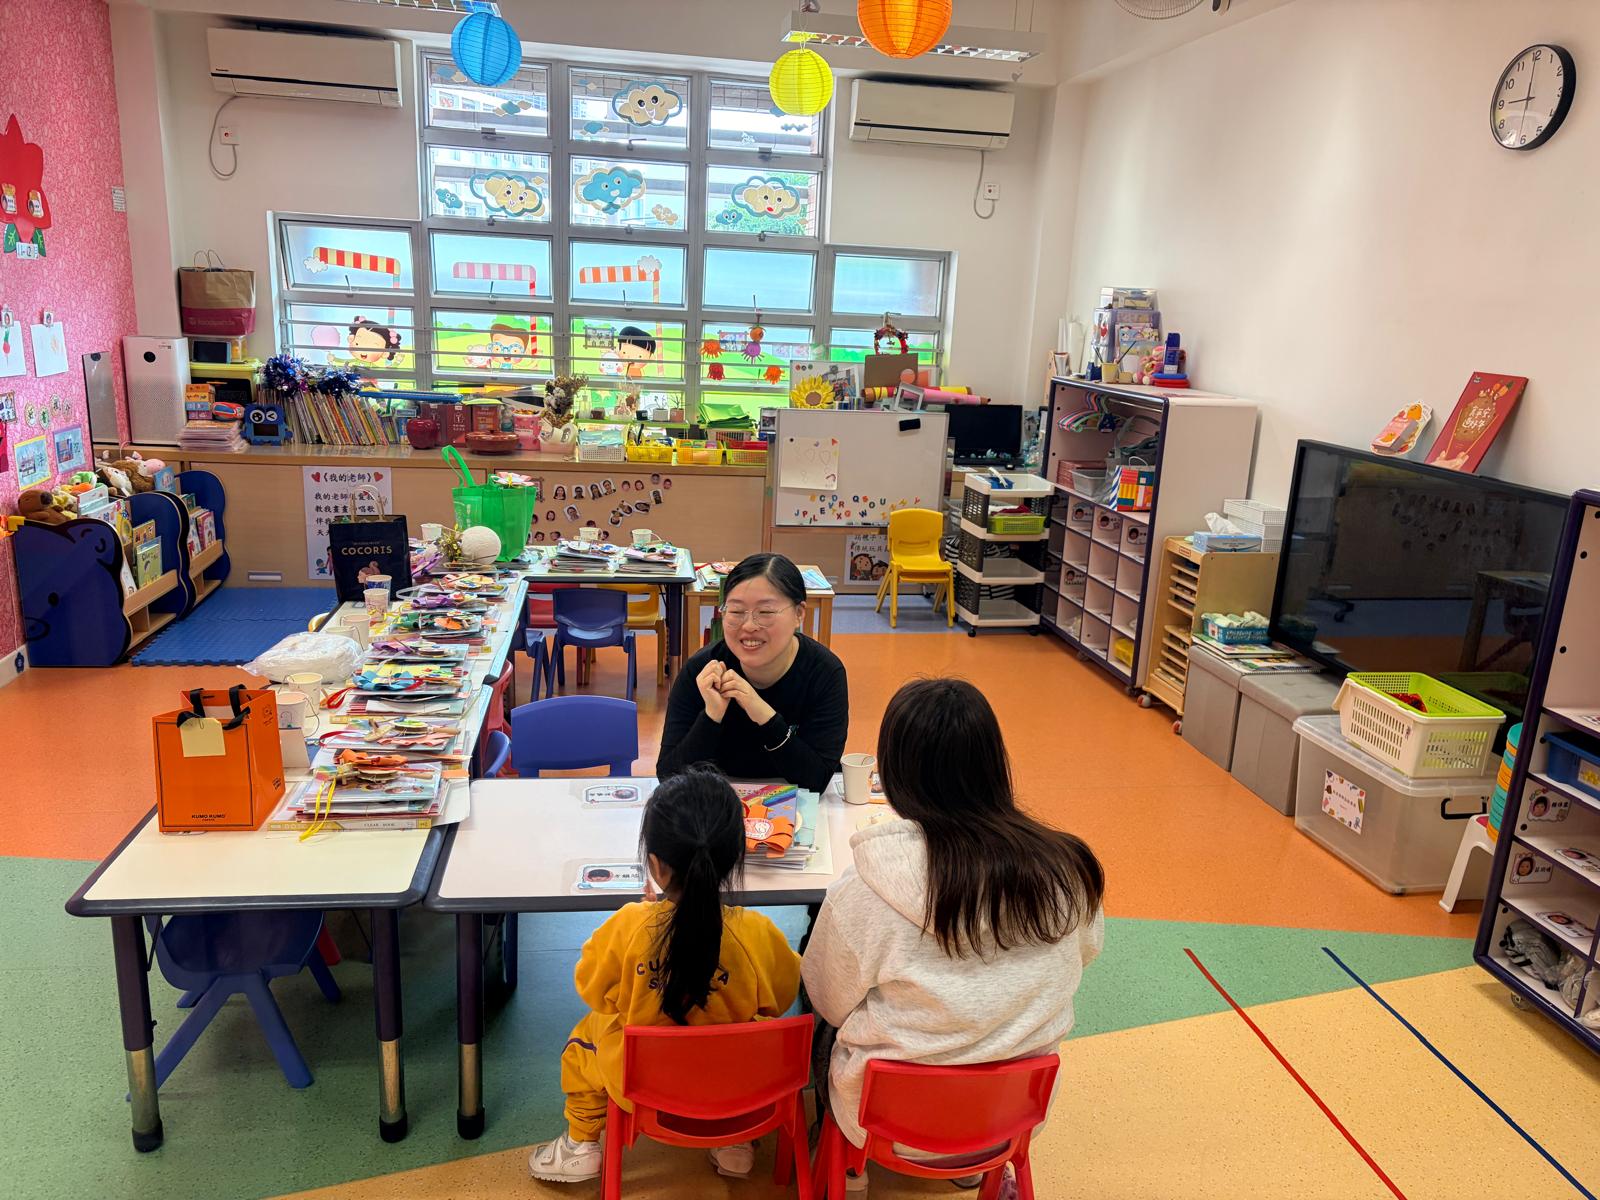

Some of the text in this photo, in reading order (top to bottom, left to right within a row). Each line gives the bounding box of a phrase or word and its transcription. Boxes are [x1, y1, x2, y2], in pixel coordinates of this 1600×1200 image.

[1532, 49, 1542, 61] 12
[1517, 61, 1525, 72] 11
[1556, 65, 1562, 76] 2
[1505, 78, 1515, 90] 10
[1498, 99, 1504, 110] 9
[1498, 119, 1505, 129] 8
[1535, 125, 1543, 136] 5
[1519, 134, 1526, 145] 6
[819, 494, 826, 502] C
[831, 494, 838, 502] D
[852, 495, 859, 503] Q
[315, 505, 375, 513] 教我畫畫唱歌
[820, 507, 826, 515] E
[859, 509, 867, 518] W
[802, 510, 808, 518] P
[813, 514, 818, 522] L
[836, 512, 842, 520] X
[341, 545, 393, 556] COCORIS
